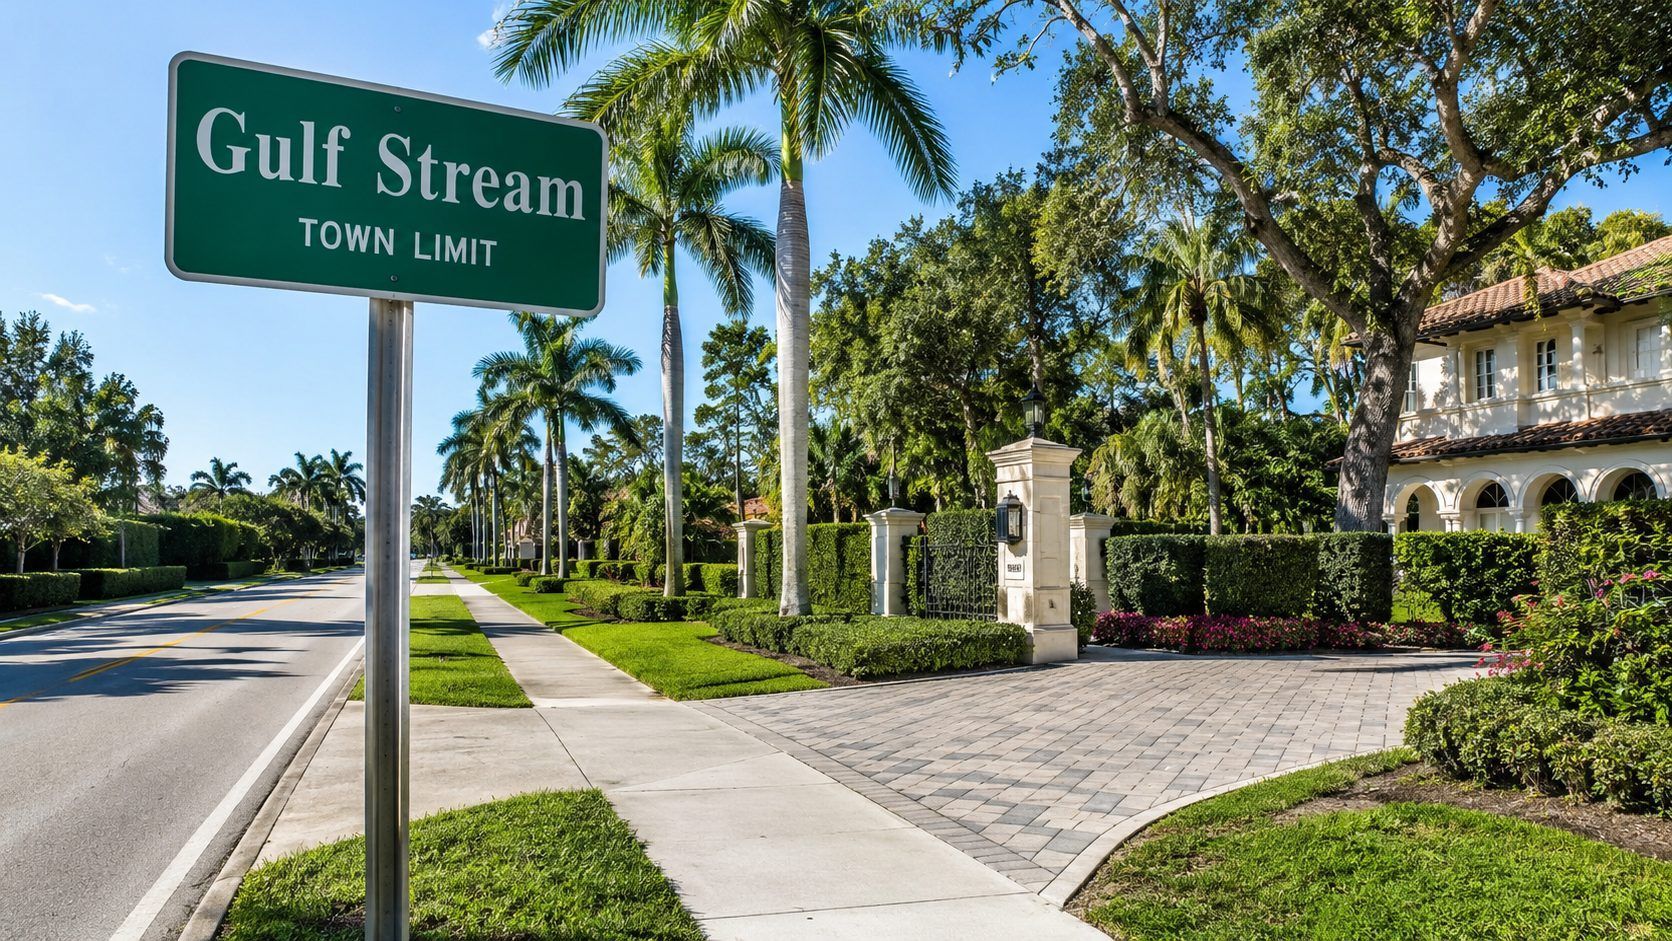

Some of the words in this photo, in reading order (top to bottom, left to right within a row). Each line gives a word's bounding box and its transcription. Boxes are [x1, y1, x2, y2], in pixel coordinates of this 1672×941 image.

[196, 107, 351, 187] Gulf
[377, 133, 586, 221] Stream
[298, 217, 395, 256] TOWN
[414, 231, 498, 267] LIMIT
